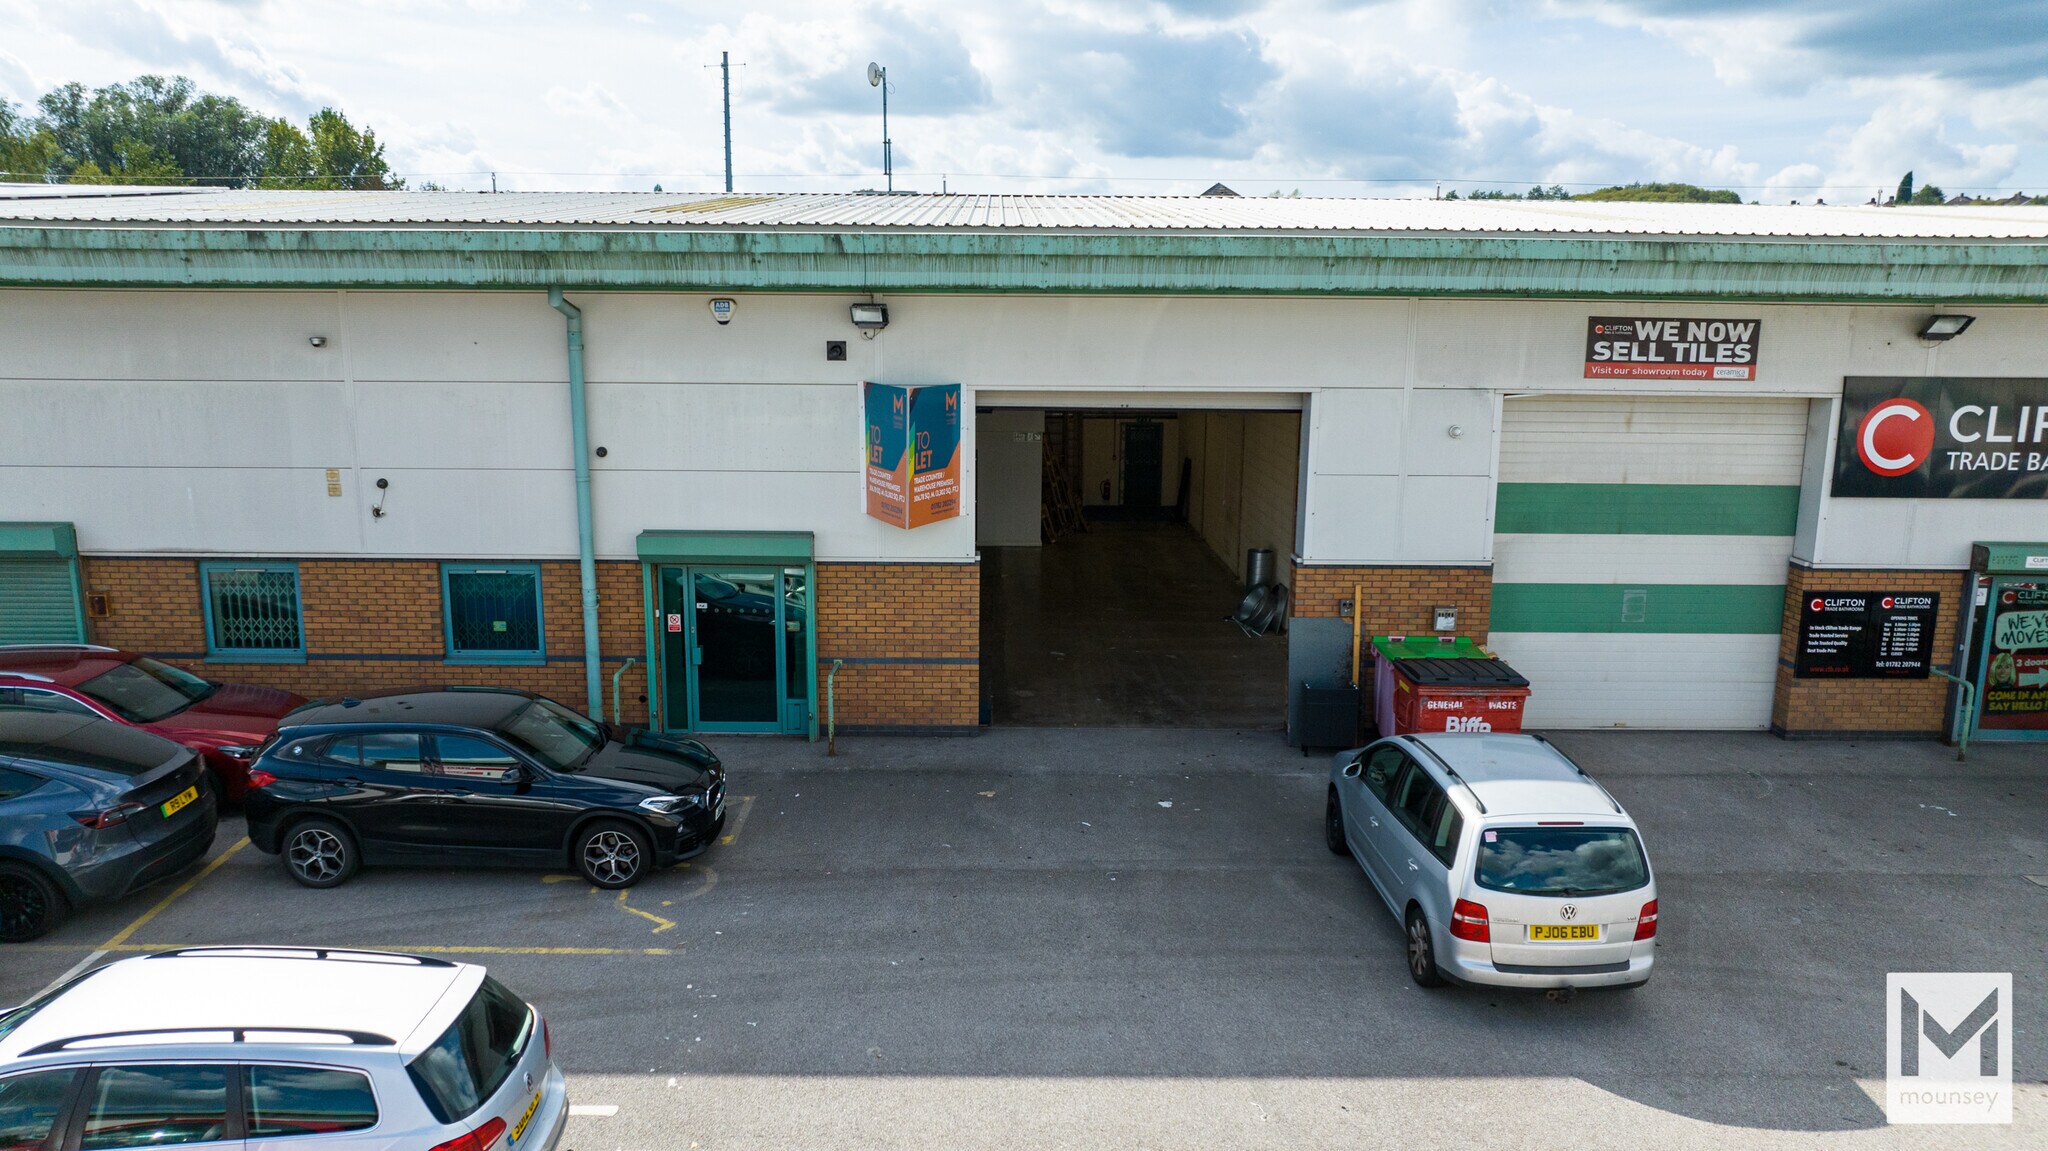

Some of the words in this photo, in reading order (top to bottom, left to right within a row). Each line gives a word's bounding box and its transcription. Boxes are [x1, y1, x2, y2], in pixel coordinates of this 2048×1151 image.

[1634, 321, 1680, 341] WE
[1687, 322, 1755, 342] NOW
[1592, 341, 1664, 362] SELL
[1672, 342, 1752, 363] TILES
[1592, 366, 1612, 374] Visit
[1632, 368, 1680, 376] showroom
[1682, 368, 1708, 378] today
[894, 394, 903, 415] M
[946, 391, 956, 411] M
[1950, 405, 2048, 442] CLIF
[870, 425, 880, 444] TO
[916, 431, 930, 450] TO
[1863, 405, 1921, 469] C
[870, 444, 883, 464] LET
[916, 450, 932, 470] LET
[1947, 452, 2021, 470] TRADE
[1824, 599, 1865, 607] CLIFTON
[1894, 597, 1931, 605] CLIFTON
[2018, 591, 2048, 599] CLIFT
[2016, 659, 2023, 667] 3
[1988, 691, 2016, 700] COME
[2018, 690, 2030, 700] IN
[2031, 690, 2048, 700] AN
[1427, 700, 1464, 710] GENERAL
[1488, 701, 1517, 709] WASTE
[1989, 702, 2010, 710] SAY
[2011, 701, 2043, 710] HELLO
[1535, 926, 1569, 938] PJ06
[1571, 926, 1594, 938] EBU
